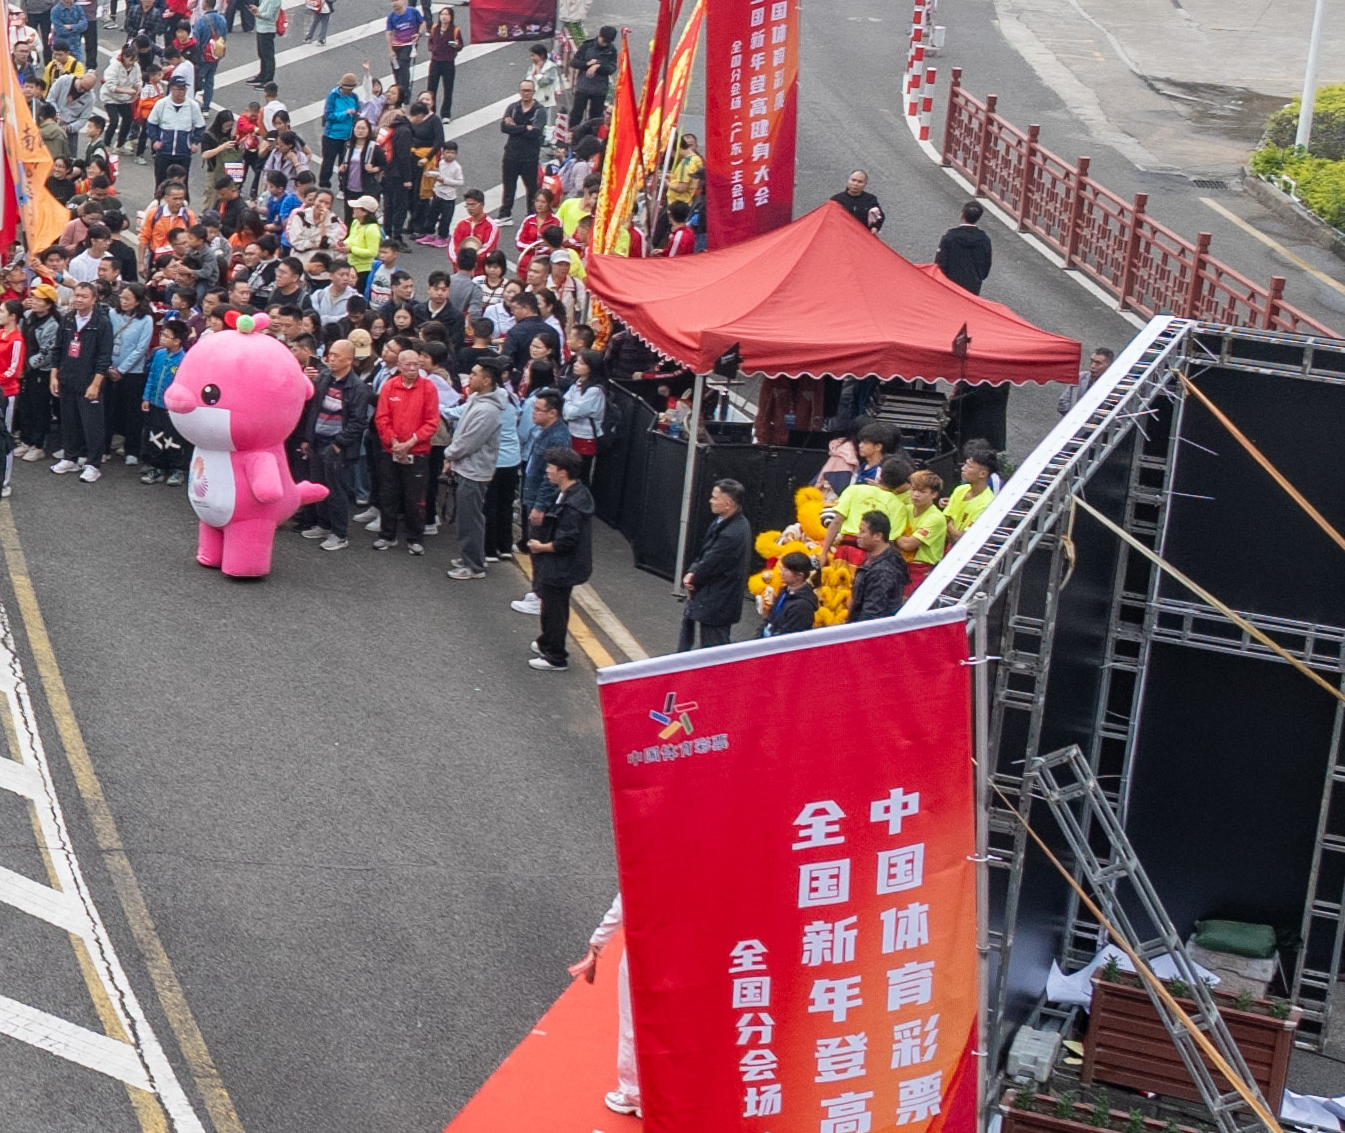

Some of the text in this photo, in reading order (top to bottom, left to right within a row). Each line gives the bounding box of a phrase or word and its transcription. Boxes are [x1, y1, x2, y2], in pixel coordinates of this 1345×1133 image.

[626, 732, 730, 767] 中国体育彩票
[791, 799, 877, 1133] 全国新年登高
[869, 786, 944, 1126] 中国体育彩票
